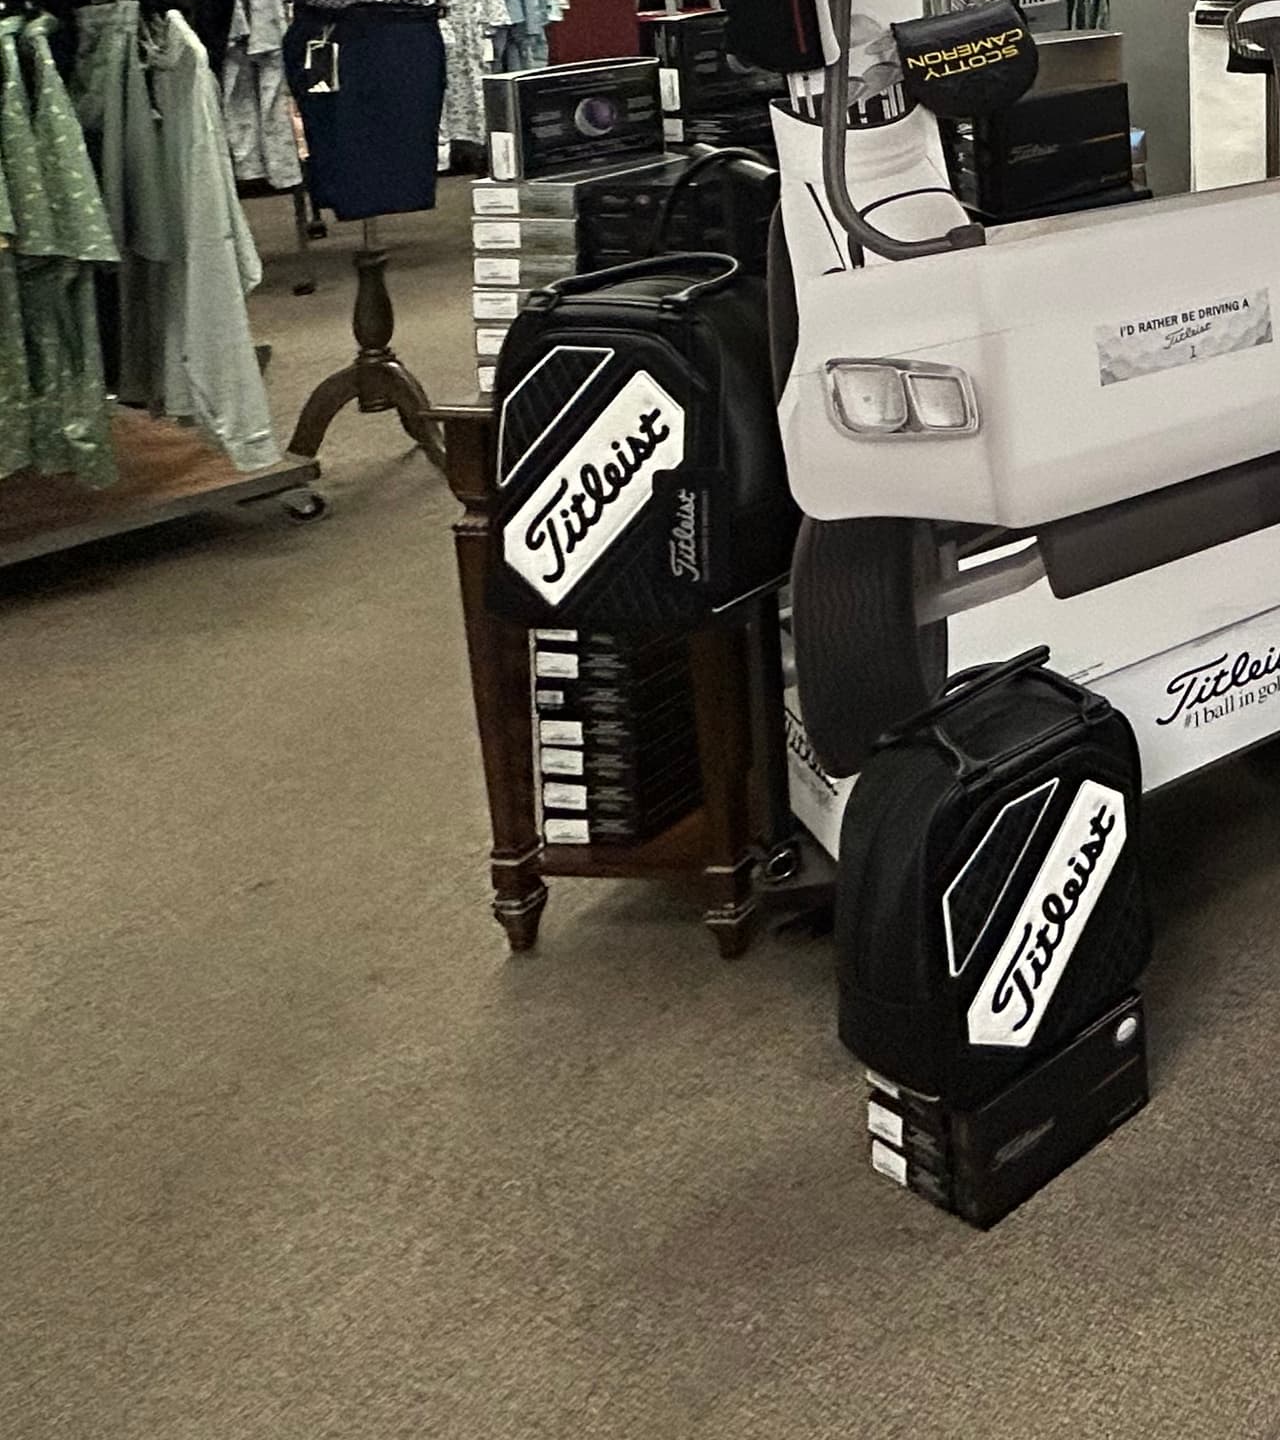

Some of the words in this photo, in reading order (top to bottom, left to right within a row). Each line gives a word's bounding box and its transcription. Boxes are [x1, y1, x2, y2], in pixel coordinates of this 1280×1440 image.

[906, 28, 1024, 70] CAMERON
[923, 44, 1020, 81] SCOTTY
[1120, 326, 1135, 338] I'D
[1138, 314, 1179, 334] RATHER
[1181, 311, 1196, 324] BE
[1198, 300, 1240, 320] DRIVING
[1242, 298, 1250, 309] A
[1163, 322, 1212, 350] Titleist
[524, 406, 671, 583] Titleist
[669, 487, 698, 583] Titleist
[1203, 695, 1235, 724] ball
[1238, 689, 1255, 709] in
[991, 804, 1117, 1033] Titleist
